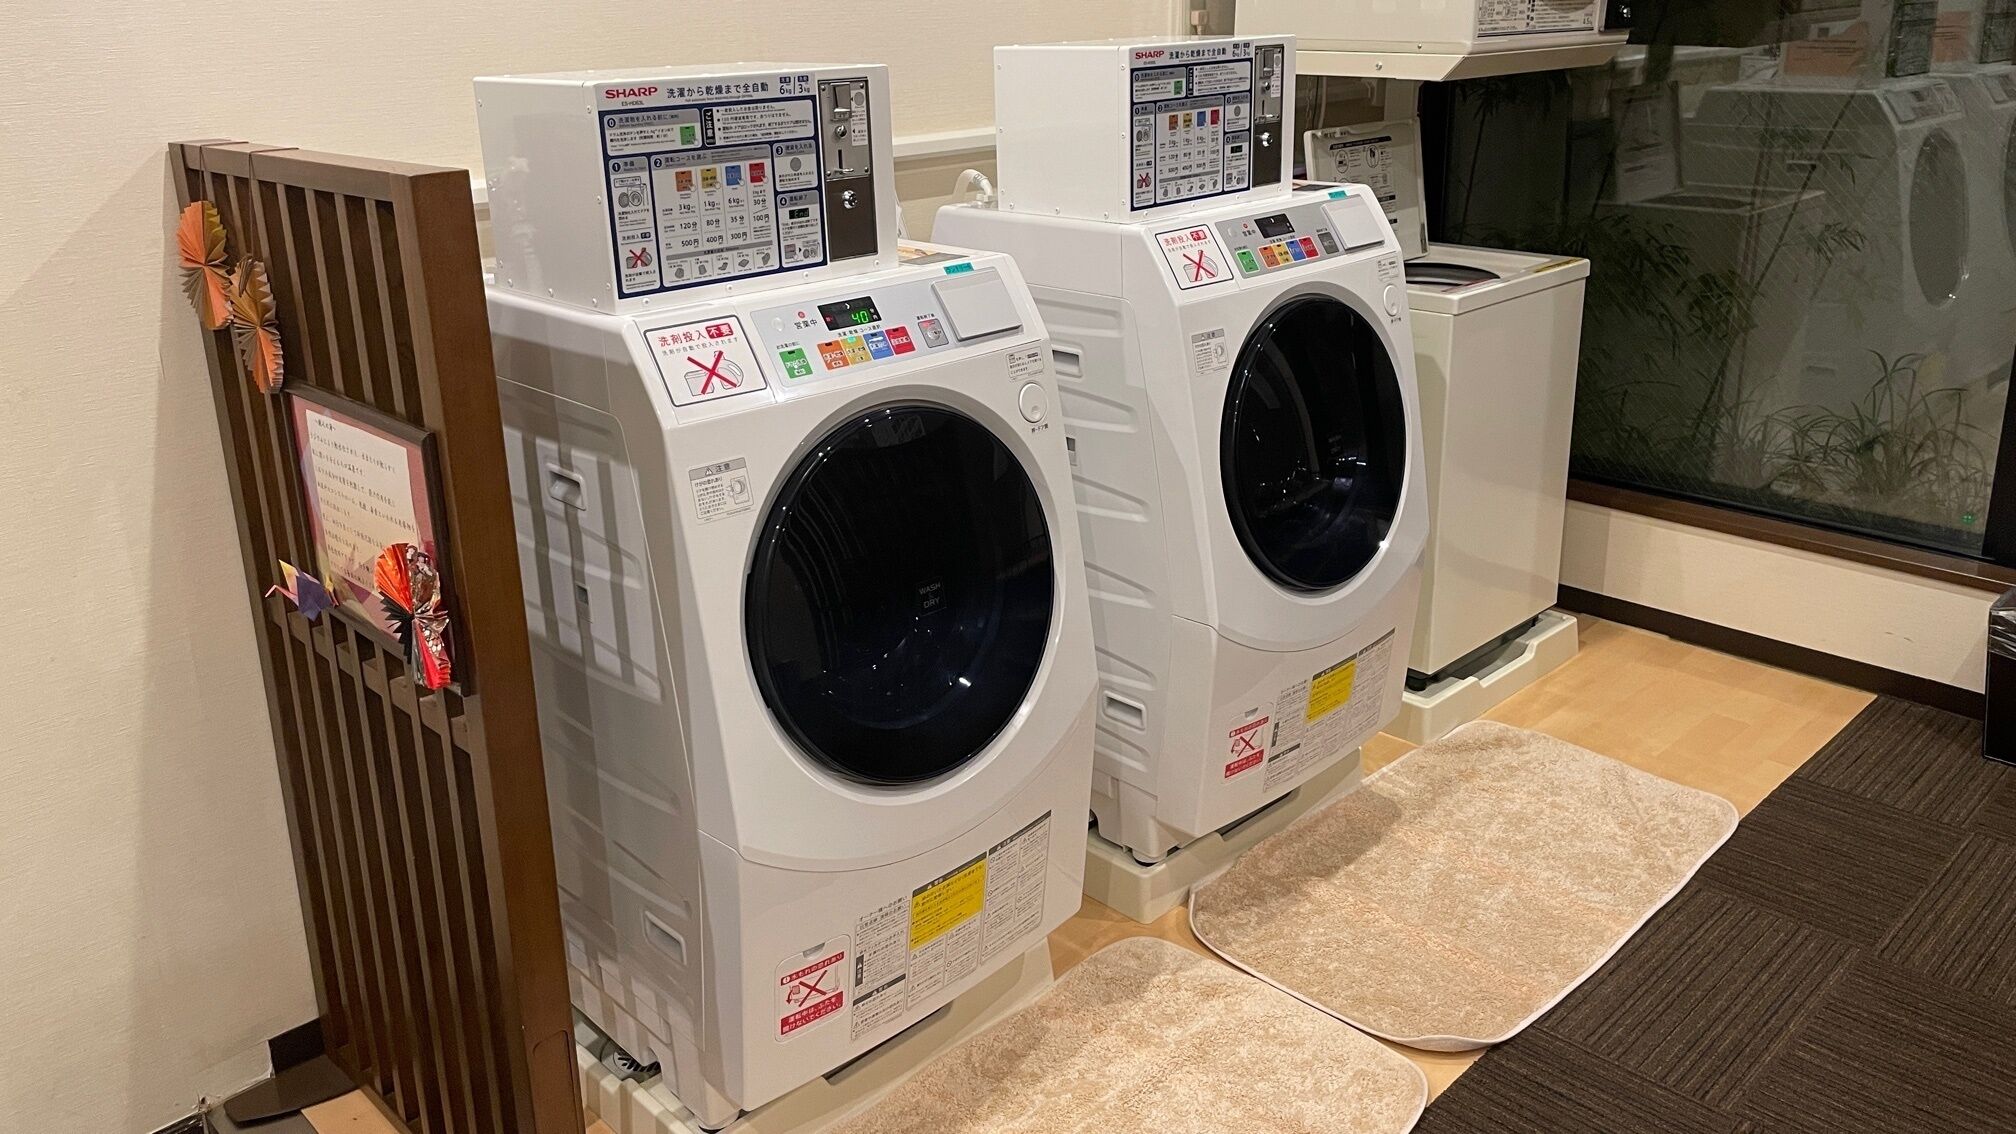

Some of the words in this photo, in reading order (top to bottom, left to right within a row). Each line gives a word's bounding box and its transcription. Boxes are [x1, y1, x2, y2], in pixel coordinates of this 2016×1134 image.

[1135, 50, 1165, 60] SHARP
[604, 86, 658, 99] SHARP
[666, 82, 769, 99] 洗濯から乾燥まで全自動
[680, 221, 698, 230] 120分
[681, 238, 699, 247] 500円
[851, 310, 869, 324] 40
[794, 318, 818, 330] 営業中
[658, 329, 706, 347] 洗剤投入
[709, 325, 732, 337] 不要
[661, 336, 738, 356] 洗剤が自動で投入されます
[716, 462, 730, 473] 注意
[919, 583, 941, 595] WASH
[923, 597, 940, 609] DRY
